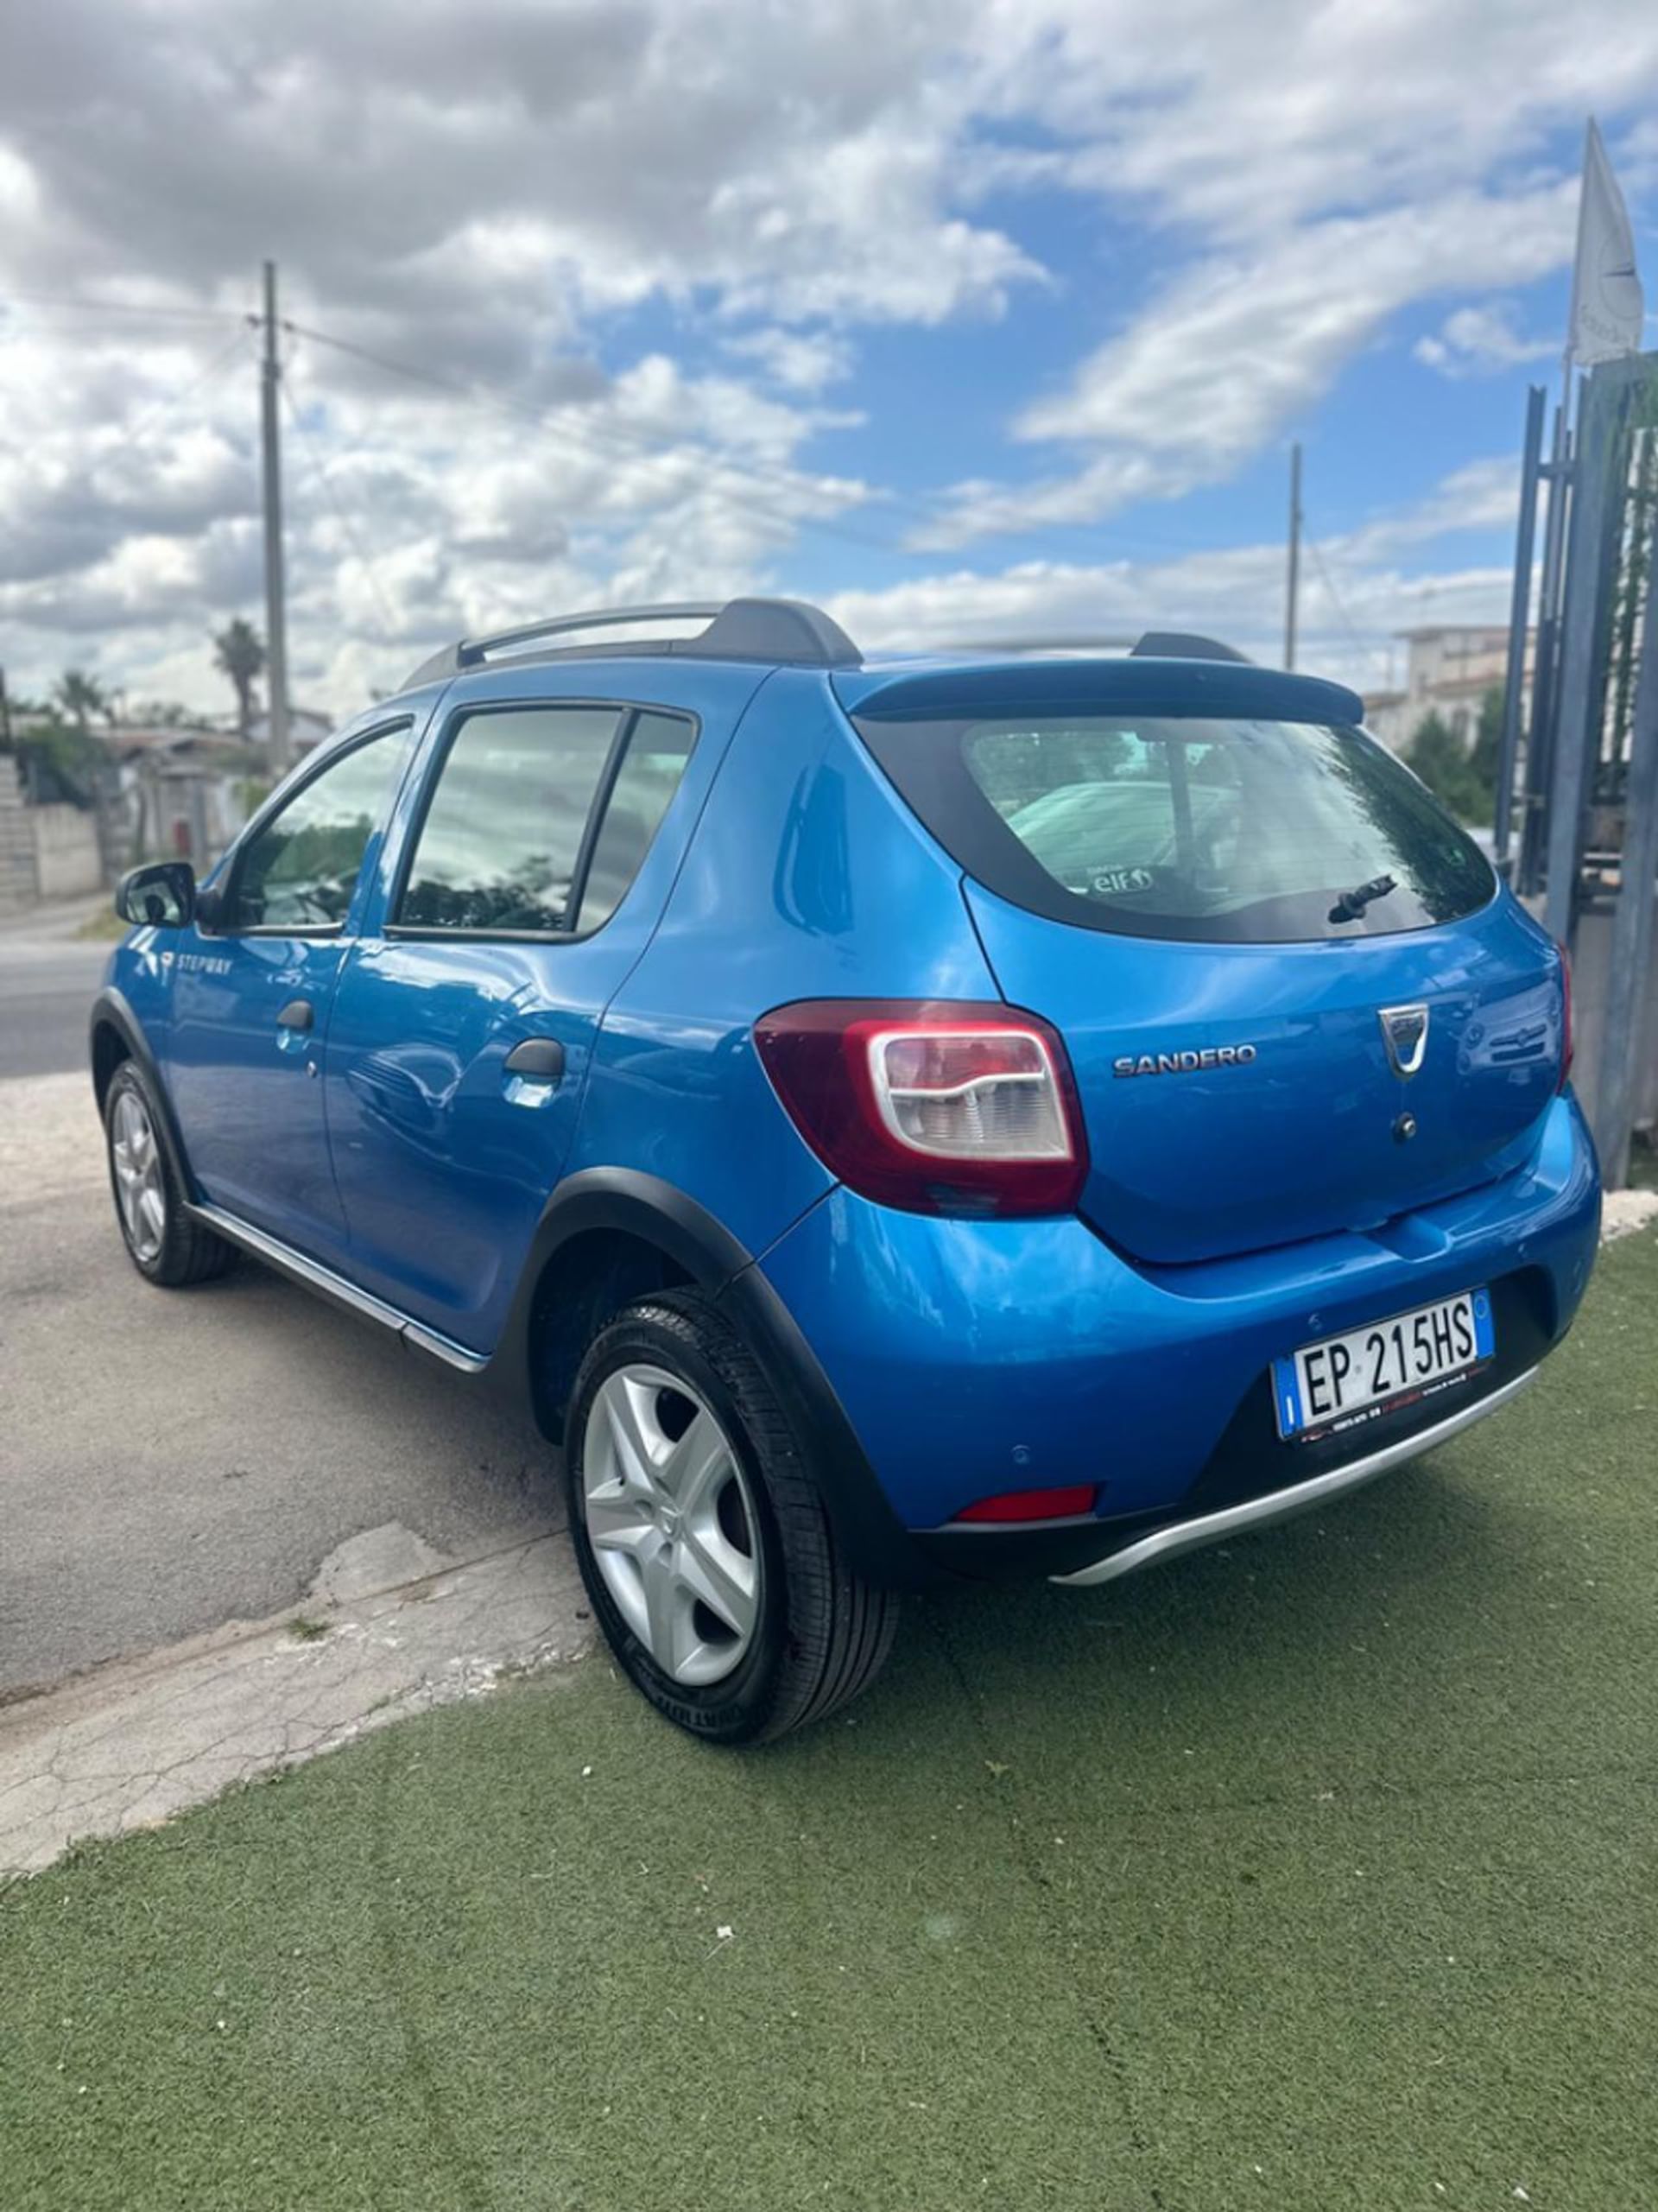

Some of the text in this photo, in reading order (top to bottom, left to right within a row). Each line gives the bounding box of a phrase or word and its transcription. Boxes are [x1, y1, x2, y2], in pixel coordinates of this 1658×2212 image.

[1113, 1043, 1256, 1078] SANDERO
[1303, 1302, 1473, 1416] EP 215HS
